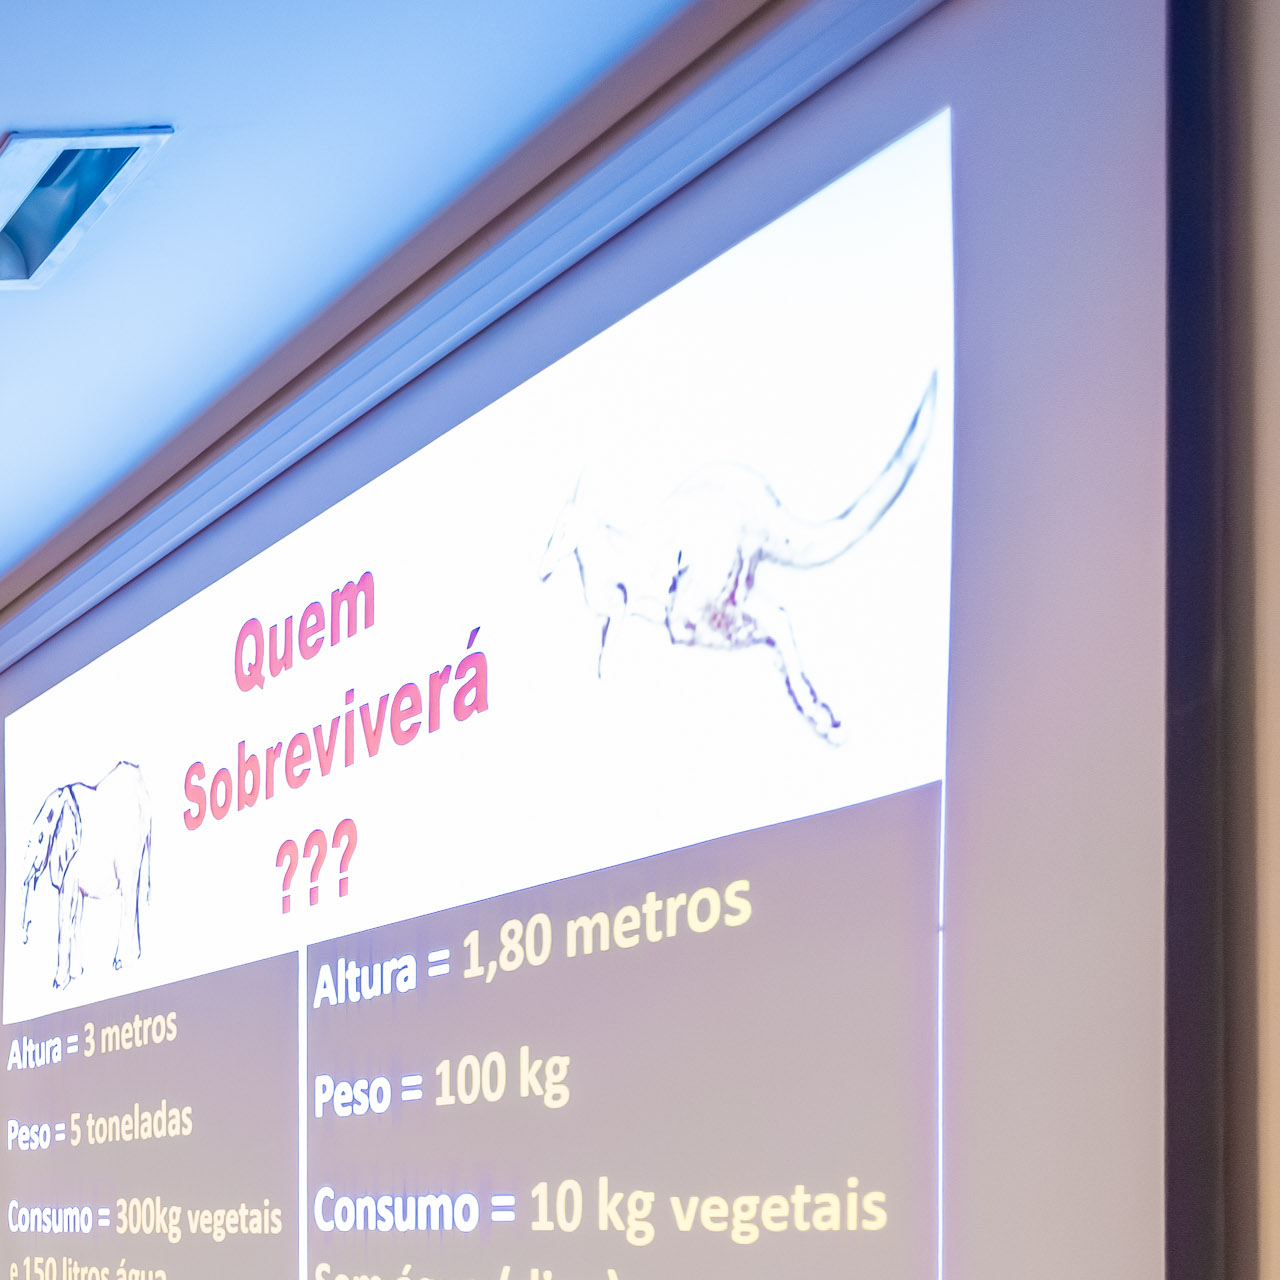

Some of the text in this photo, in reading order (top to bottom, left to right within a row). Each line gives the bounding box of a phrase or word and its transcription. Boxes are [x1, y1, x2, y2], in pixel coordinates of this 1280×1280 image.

[234, 570, 375, 693] Quem
[183, 626, 489, 831] Sobreviverá
[275, 818, 358, 914] ???
[313, 879, 753, 1010] Altura = 1,80 metros
[7, 1011, 178, 1071] Altura = 3 metros
[313, 1045, 571, 1119] Peso = 100 kg
[7, 1098, 193, 1151] Peso = 5 toneladas
[7, 1196, 283, 1244] Consumo = 300kg vegetais
[313, 1175, 888, 1247] Consumo = 10 kg vegetais
